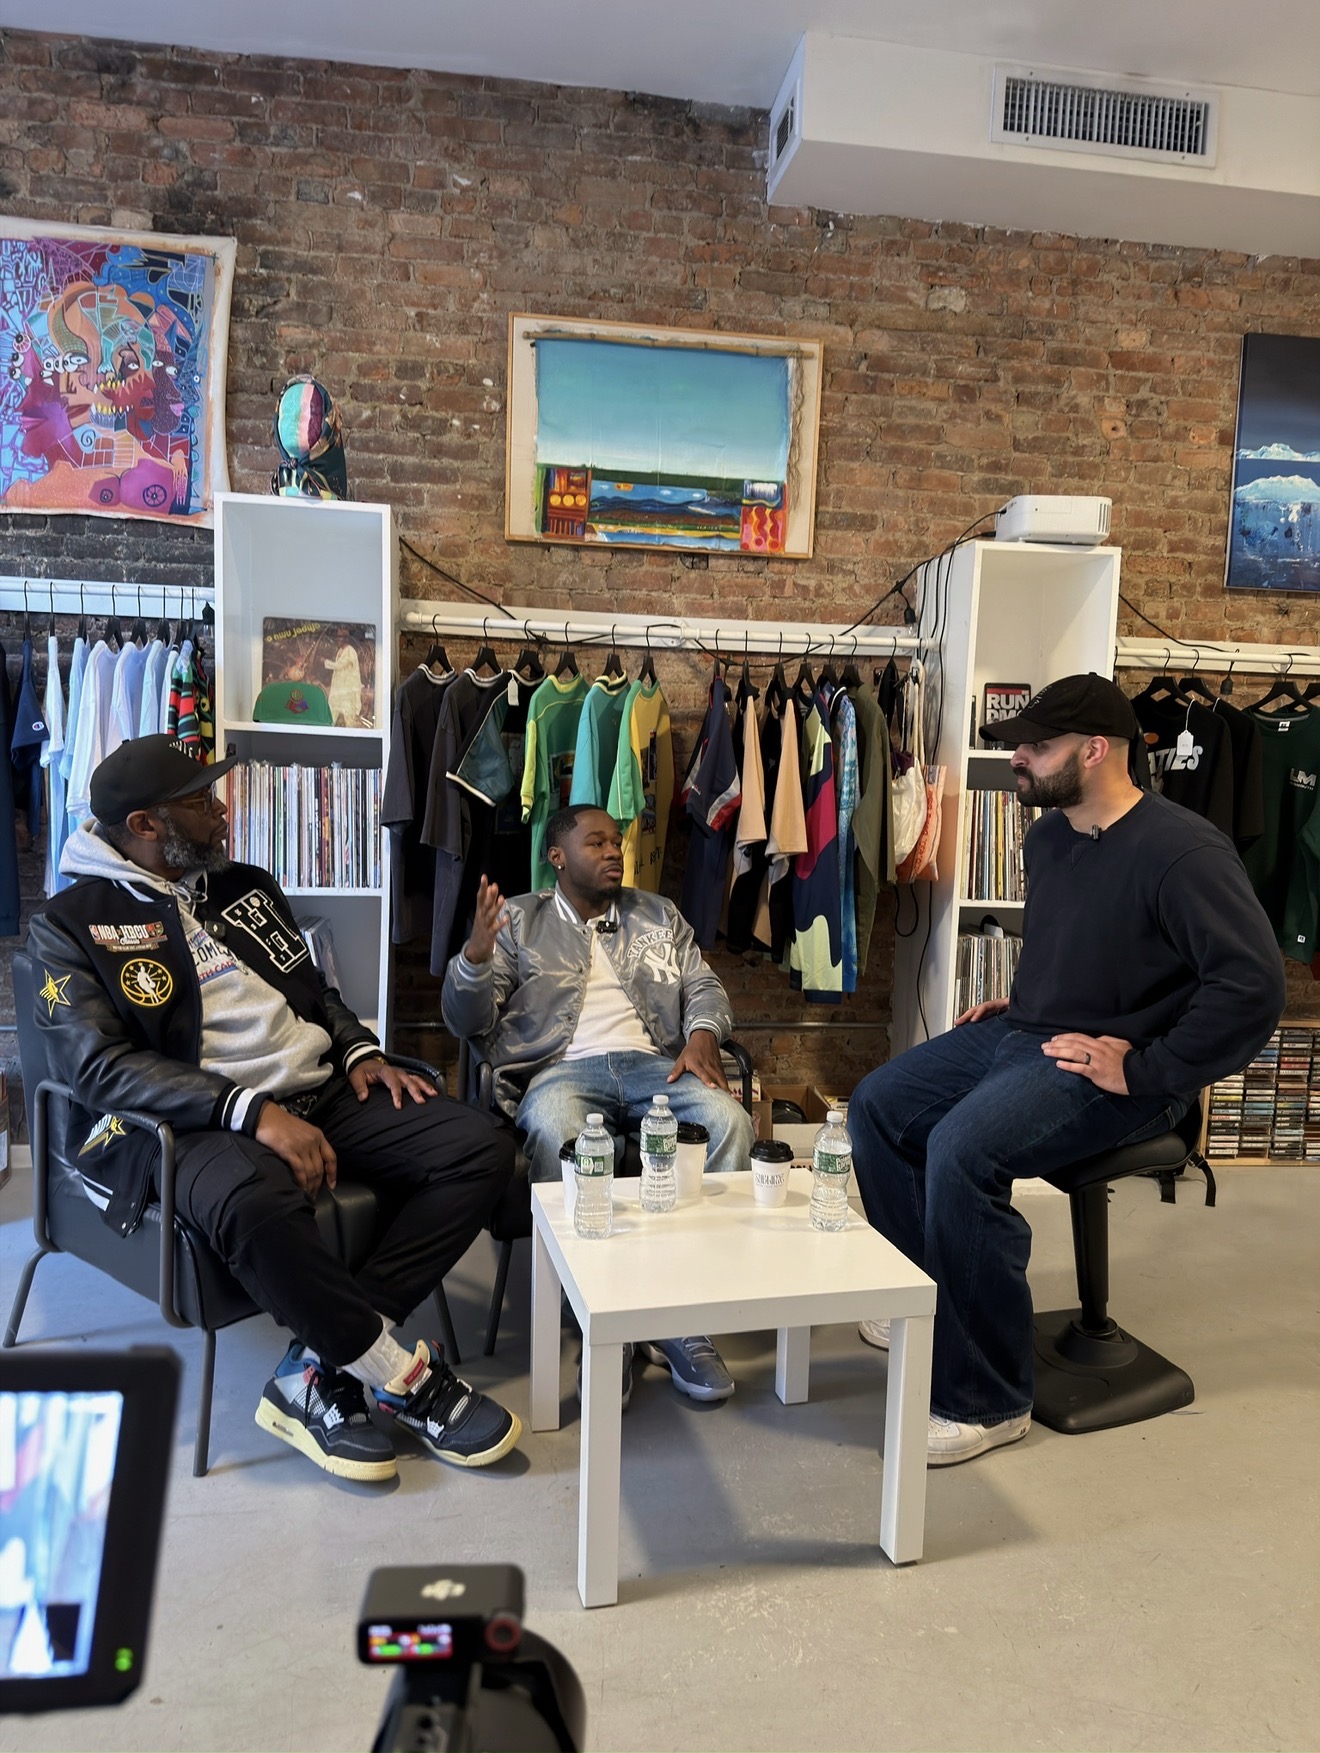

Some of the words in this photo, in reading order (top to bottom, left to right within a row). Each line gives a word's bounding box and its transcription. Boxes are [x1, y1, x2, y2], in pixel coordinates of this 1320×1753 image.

[987, 693, 1030, 710] RUN
[986, 709, 1022, 725] DM
[97, 925, 120, 941] NBA
[120, 925, 149, 939] HBCU
[627, 928, 674, 959] YANKEE
[643, 942, 681, 985] NY
